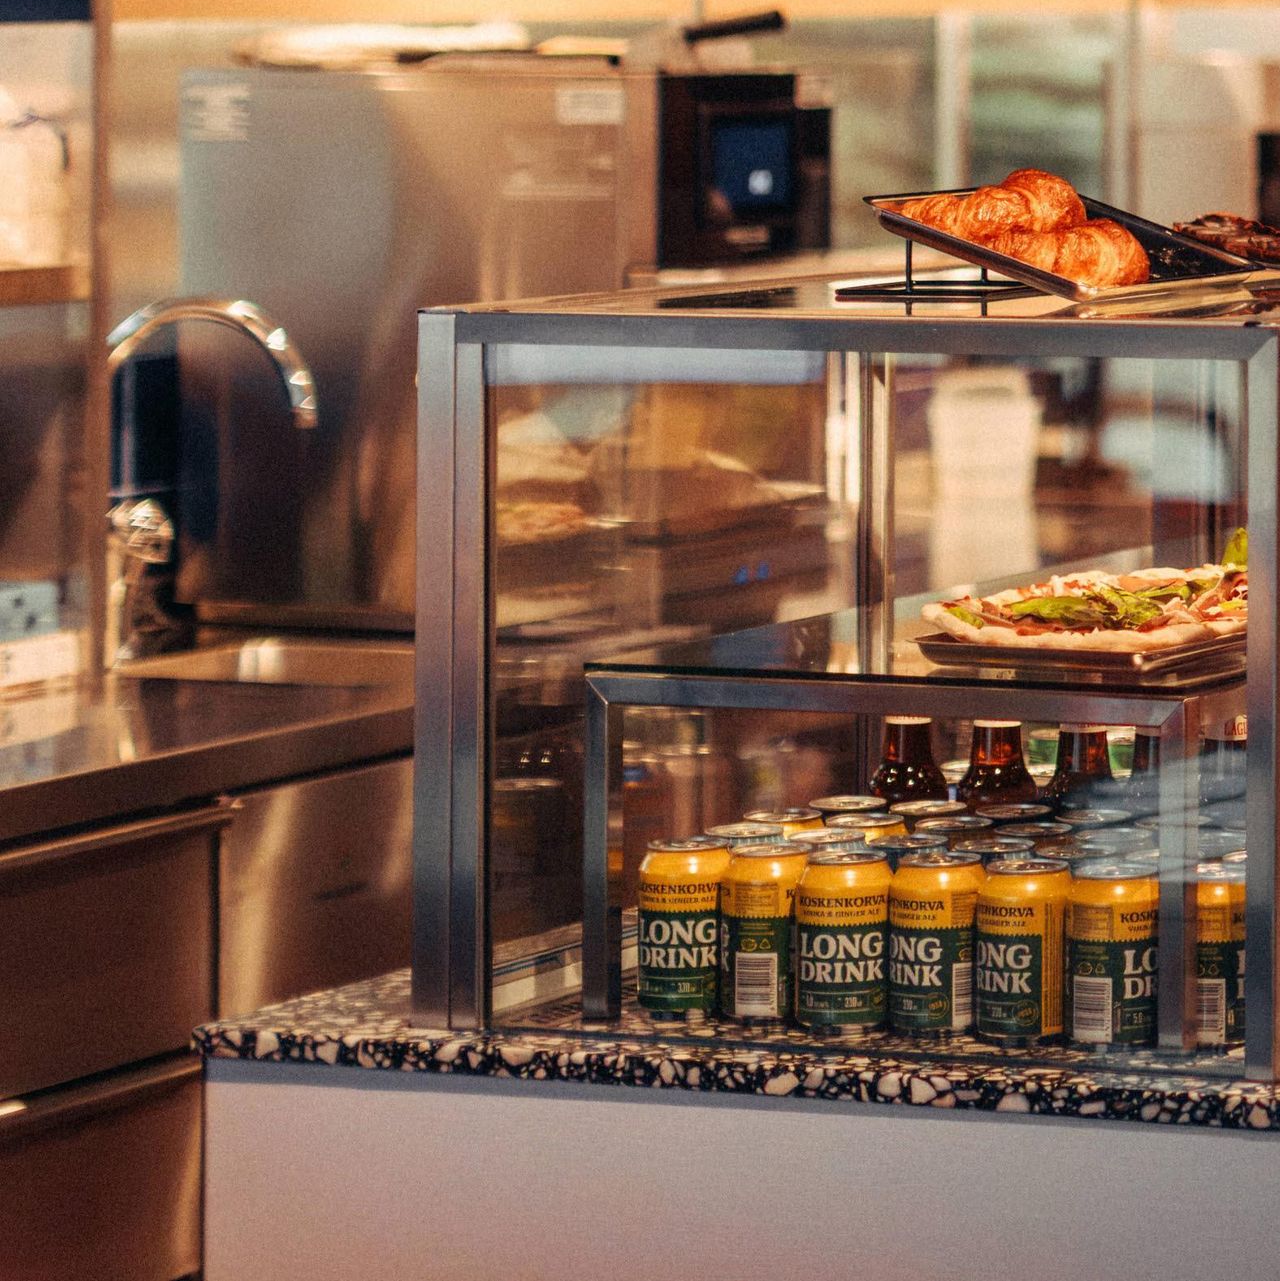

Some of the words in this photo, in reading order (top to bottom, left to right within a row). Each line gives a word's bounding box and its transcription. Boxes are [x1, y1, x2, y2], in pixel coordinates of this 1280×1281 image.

[640, 918, 717, 946] LONG
[640, 945, 717, 970] DRINK
[800, 931, 884, 960] LONG
[800, 959, 884, 984] DRINK
